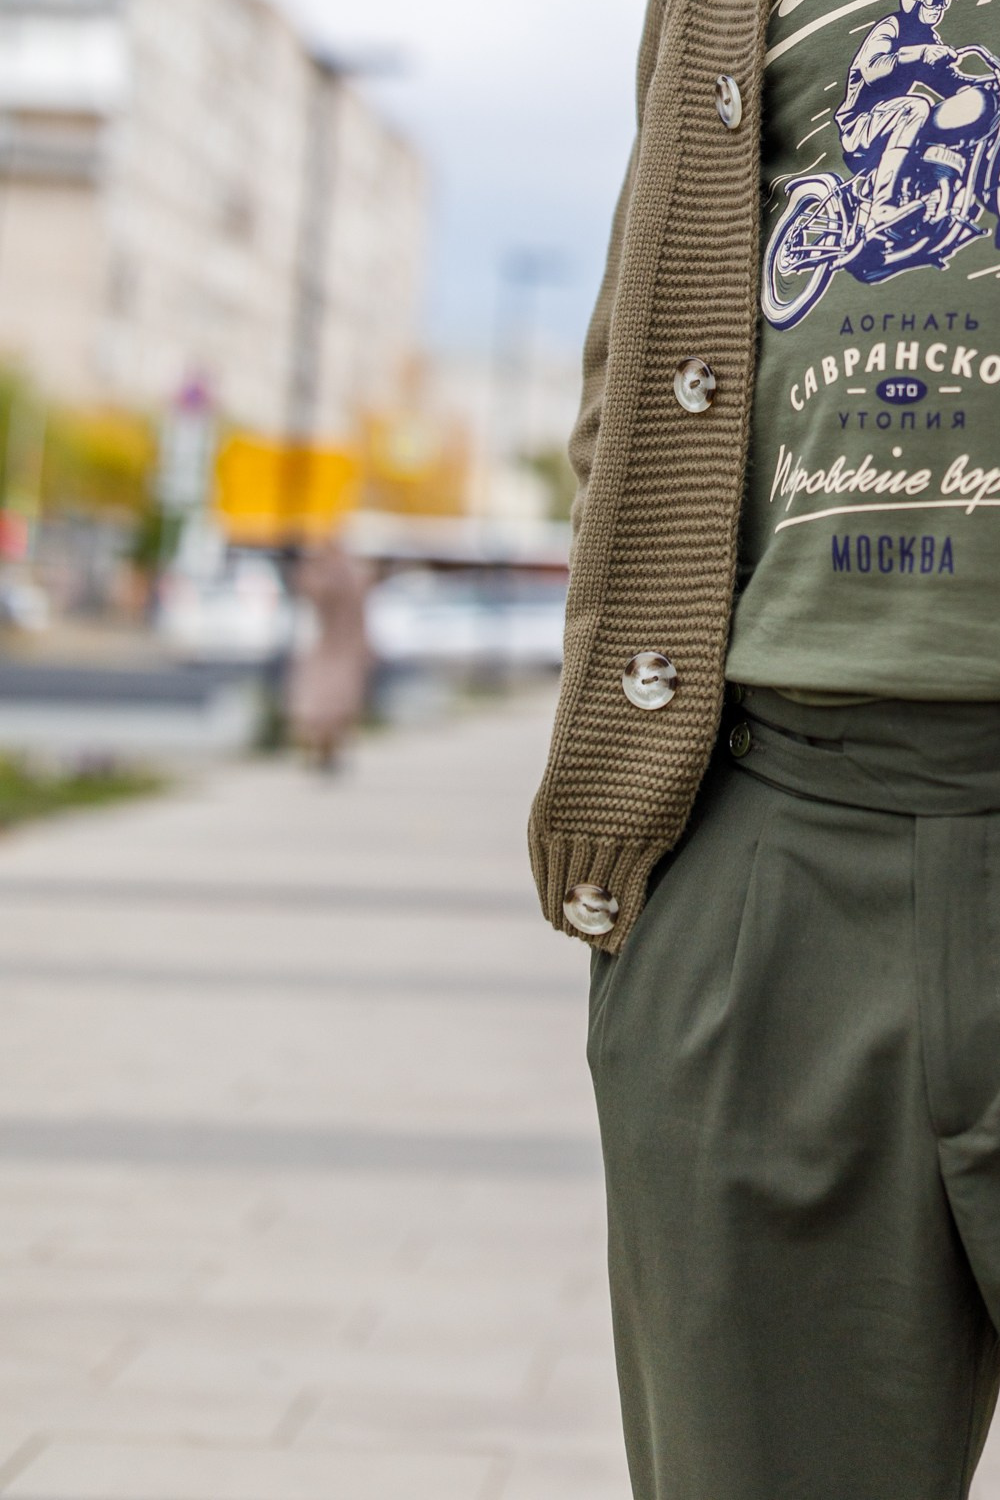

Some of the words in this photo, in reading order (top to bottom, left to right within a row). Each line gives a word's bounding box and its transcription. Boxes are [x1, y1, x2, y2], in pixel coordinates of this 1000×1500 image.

[839, 312, 979, 335] ДОГНАТЬ
[885, 383, 918, 398] ЭТО
[838, 411, 966, 430] УТОПИЯ
[832, 535, 955, 574] МОСКВА
